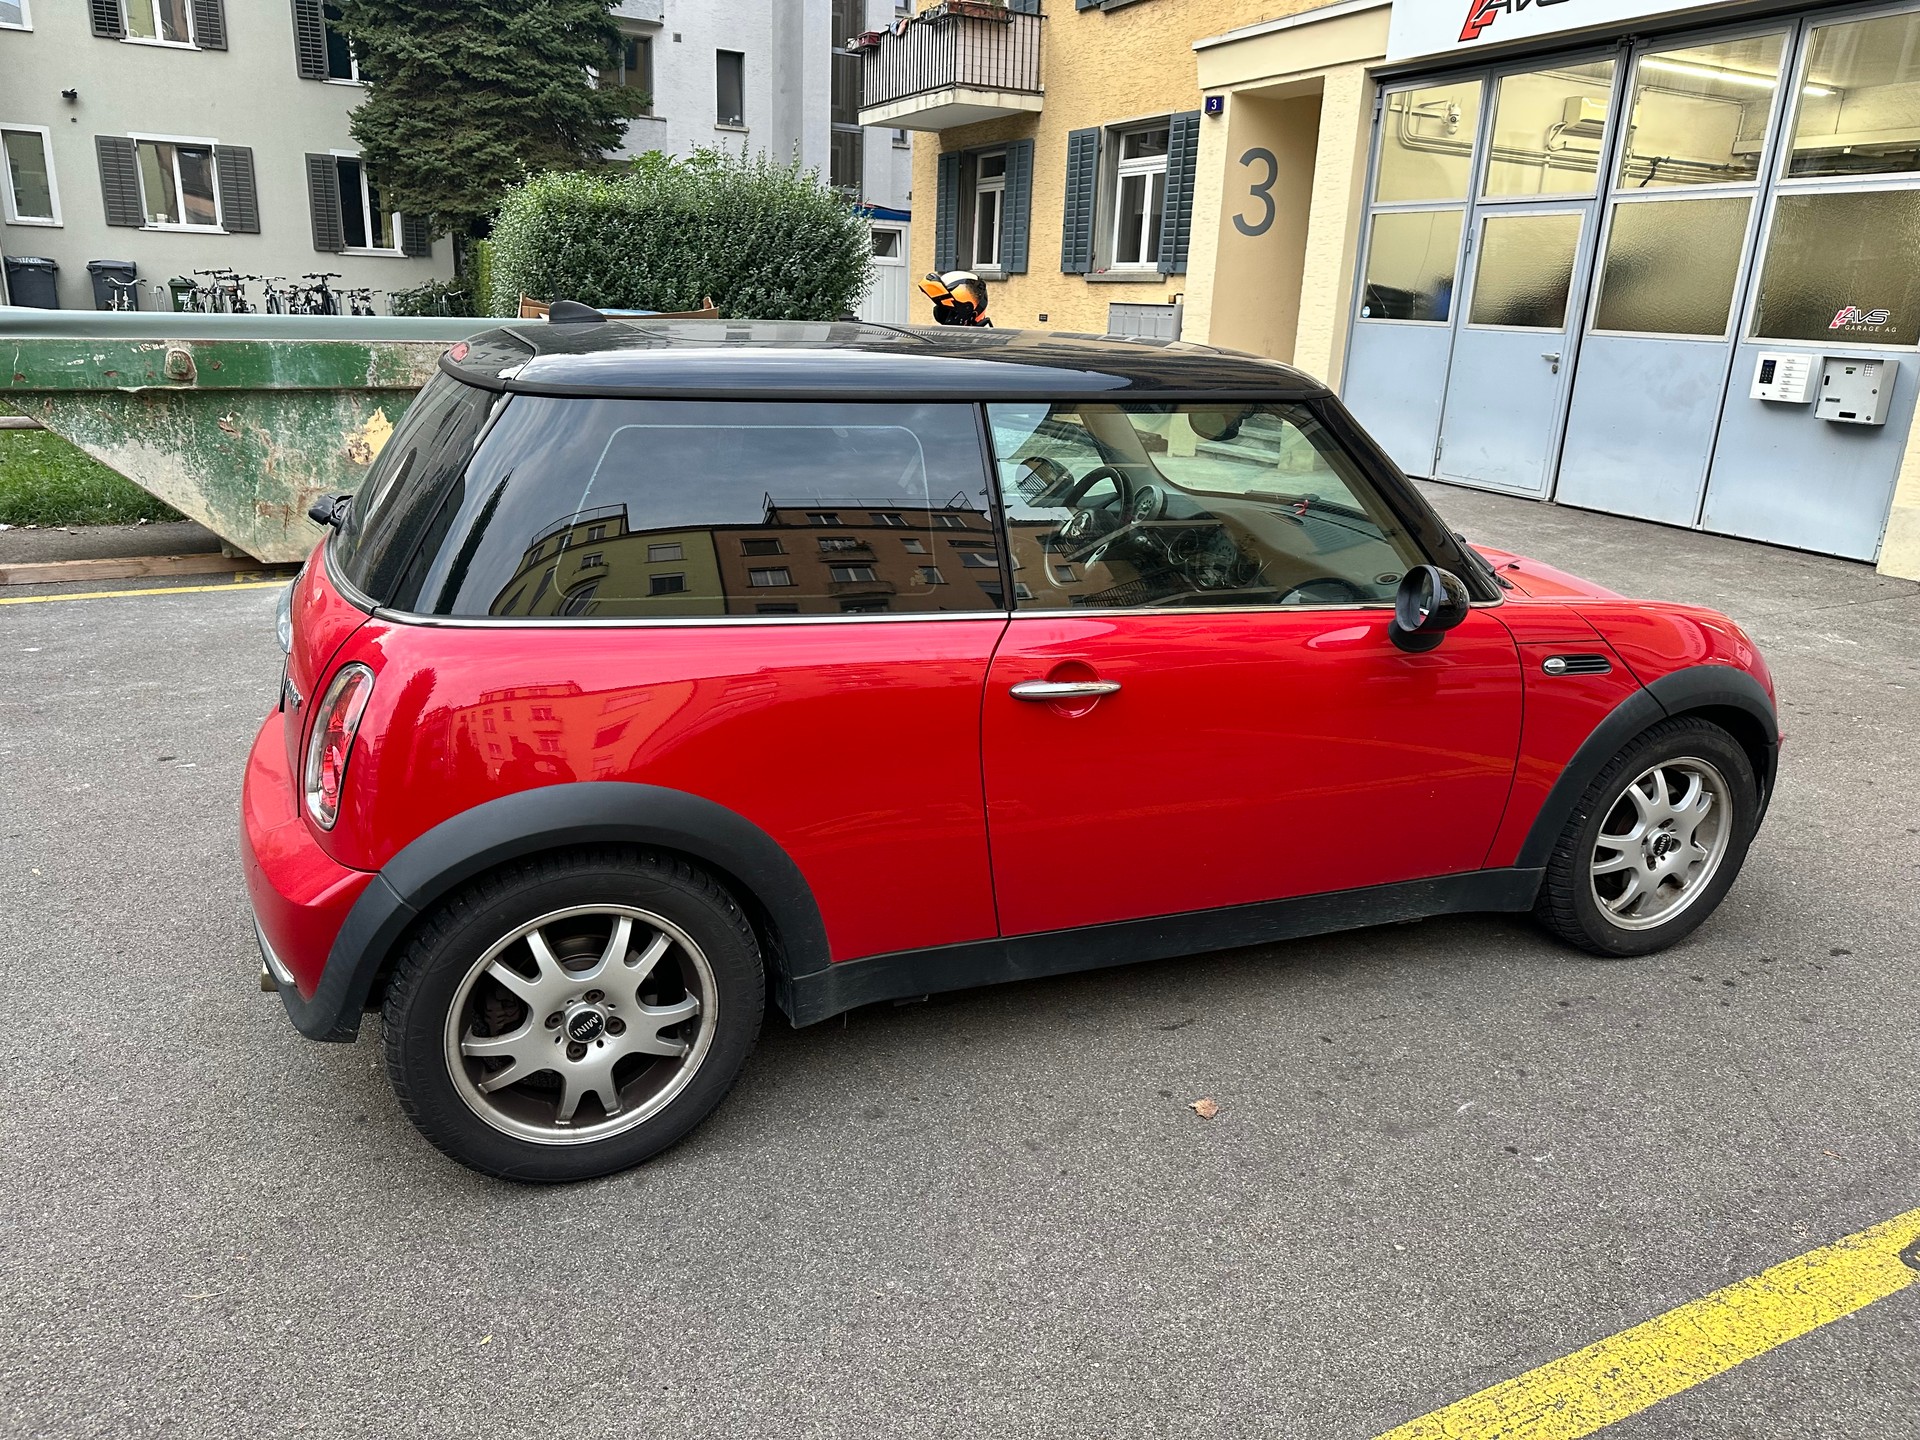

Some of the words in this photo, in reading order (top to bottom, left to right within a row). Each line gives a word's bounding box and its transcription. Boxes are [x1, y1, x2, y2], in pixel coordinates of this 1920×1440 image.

[1211, 98, 1218, 110] 3
[1232, 147, 1279, 237] 3
[1834, 308, 1890, 325] AVS
[1844, 324, 1880, 333] GARAGE
[573, 1014, 599, 1038] MINI
